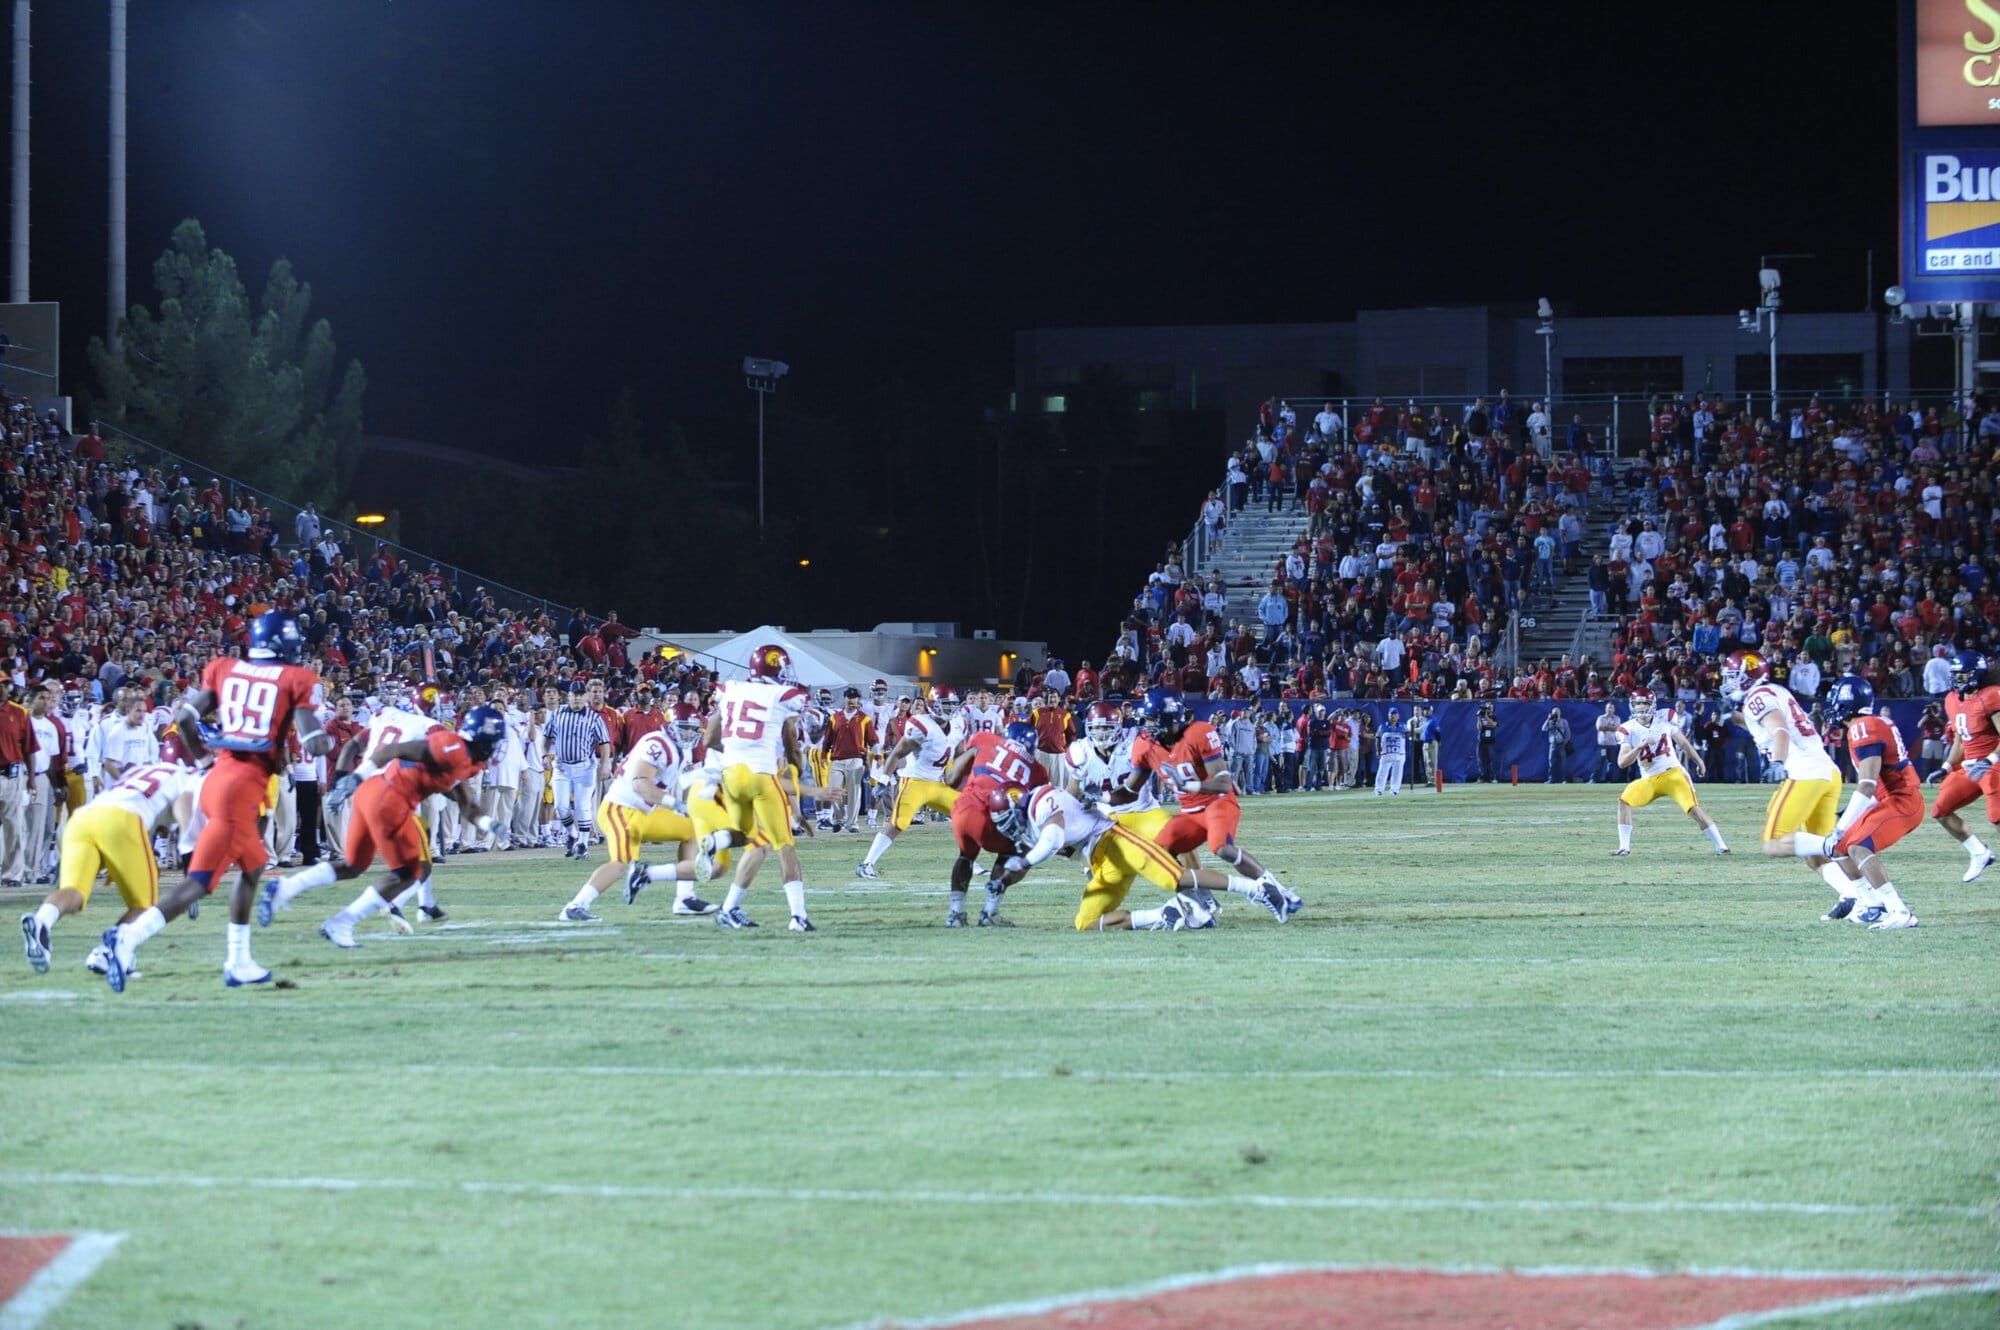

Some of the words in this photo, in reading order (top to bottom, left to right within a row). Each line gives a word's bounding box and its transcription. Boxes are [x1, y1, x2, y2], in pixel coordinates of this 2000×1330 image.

[1930, 255, 1956, 267] car
[1963, 252, 1993, 266] and
[1519, 617, 1536, 628] 26
[220, 677, 278, 736] 89
[1748, 696, 1766, 716] 88
[722, 700, 768, 740] 15
[1850, 722, 1869, 742] 81
[645, 743, 663, 762] 54
[932, 746, 952, 767] 4
[1639, 732, 1671, 762] 44
[985, 744, 1032, 786] 10
[1046, 796, 1060, 812] 2
